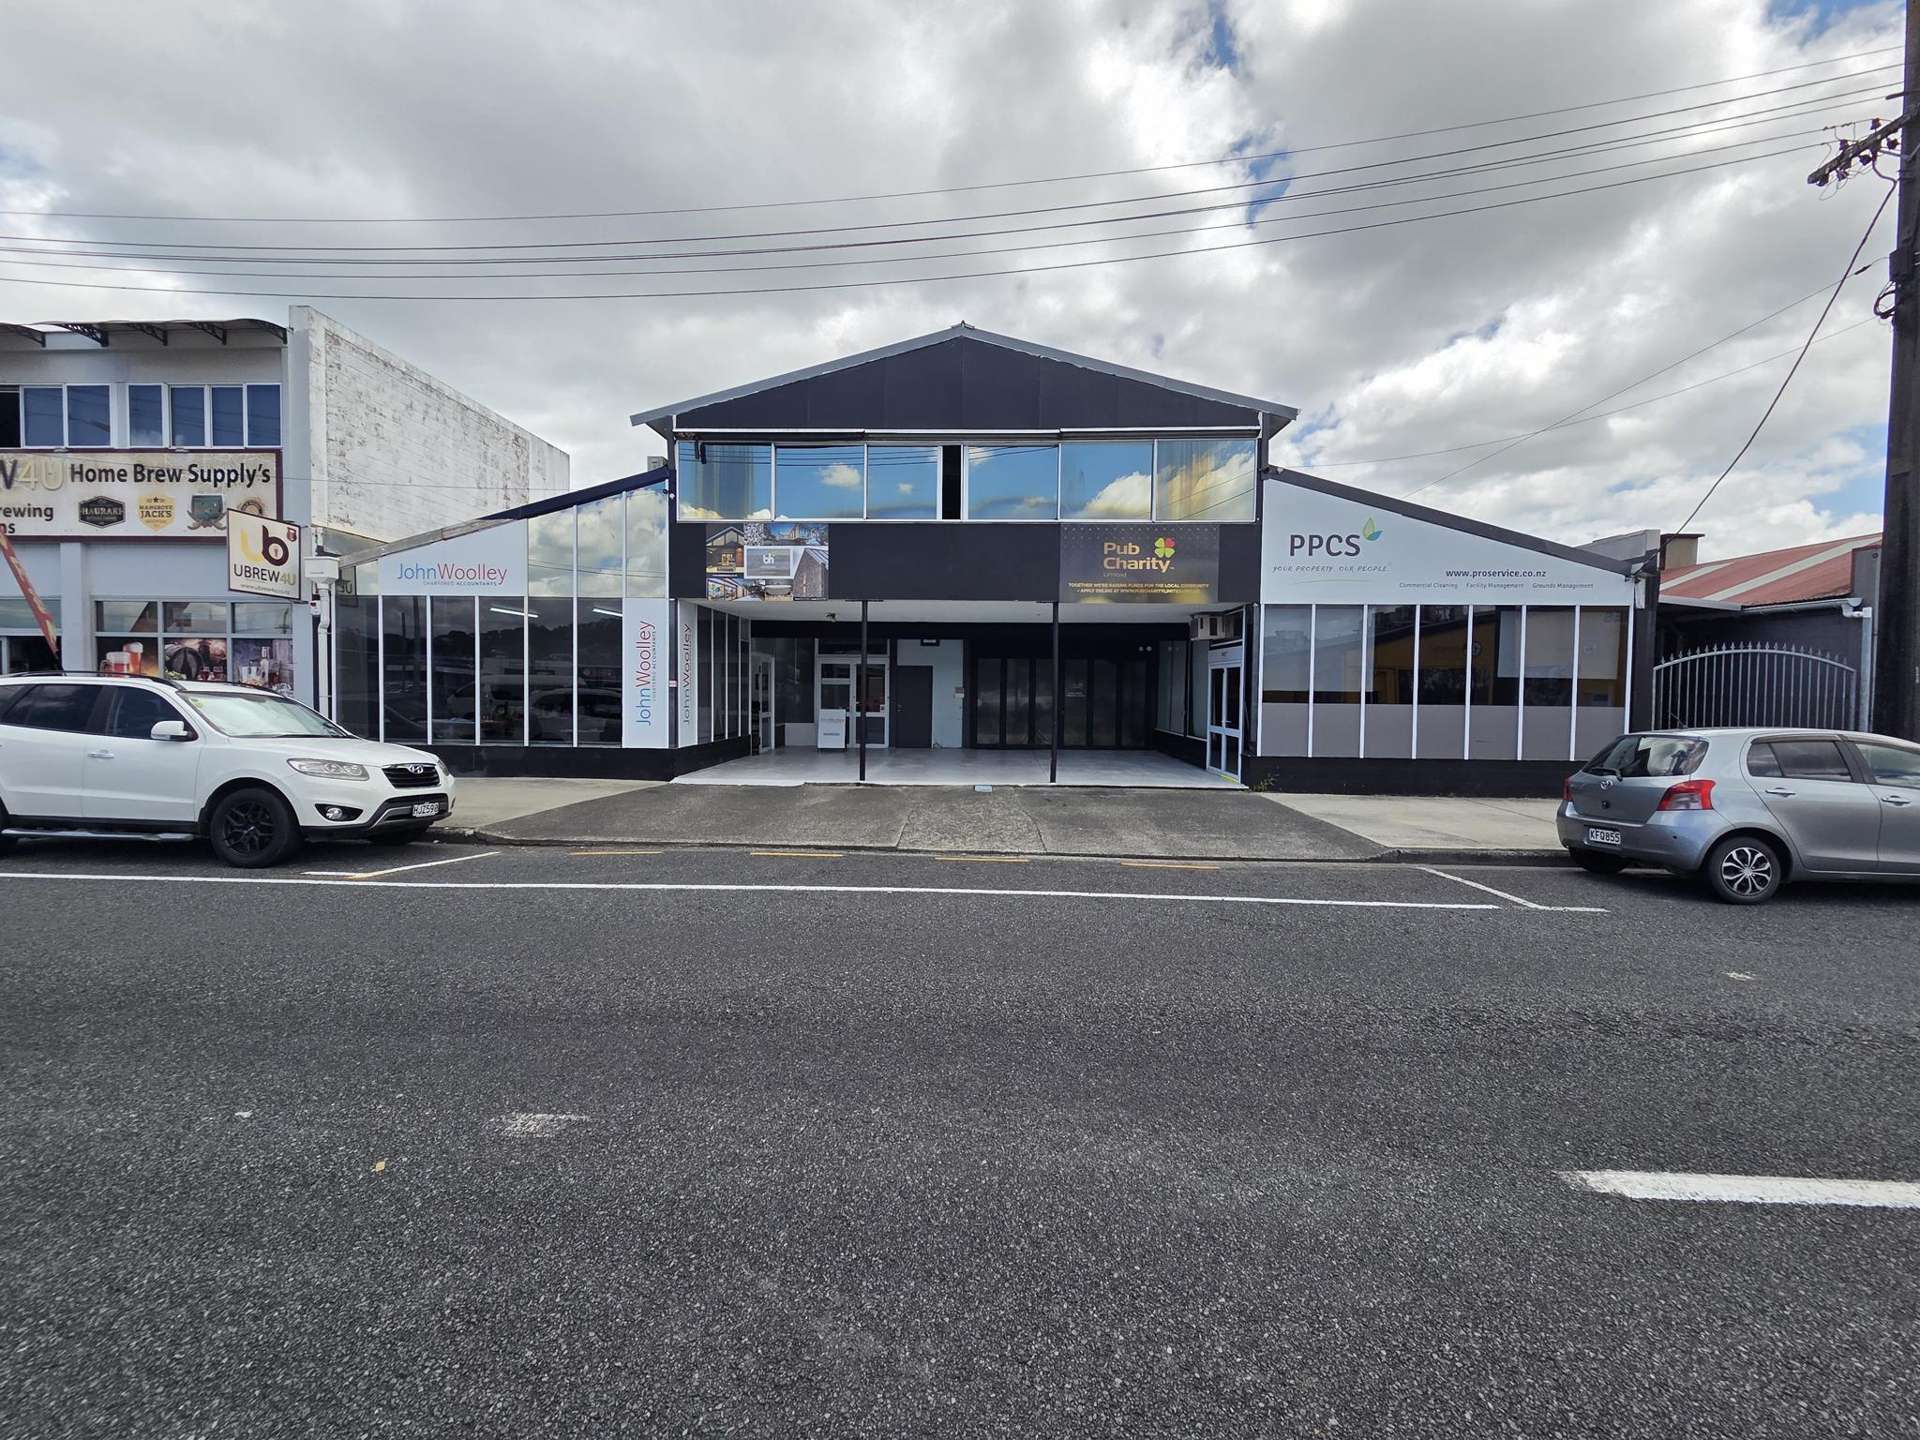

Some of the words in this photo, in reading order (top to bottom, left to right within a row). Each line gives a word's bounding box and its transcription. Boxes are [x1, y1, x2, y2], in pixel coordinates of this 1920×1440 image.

[71, 464, 127, 483] Home
[134, 464, 182, 482] Brew
[188, 463, 271, 488] Supply's
[140, 511, 172, 519] JACK'S
[1104, 542, 1140, 555] Pub
[1290, 534, 1361, 556] PPCS
[1104, 557, 1170, 573] Charity
[234, 563, 297, 586] UBREW4U
[1445, 568, 1547, 580] www.proservice.co.nz
